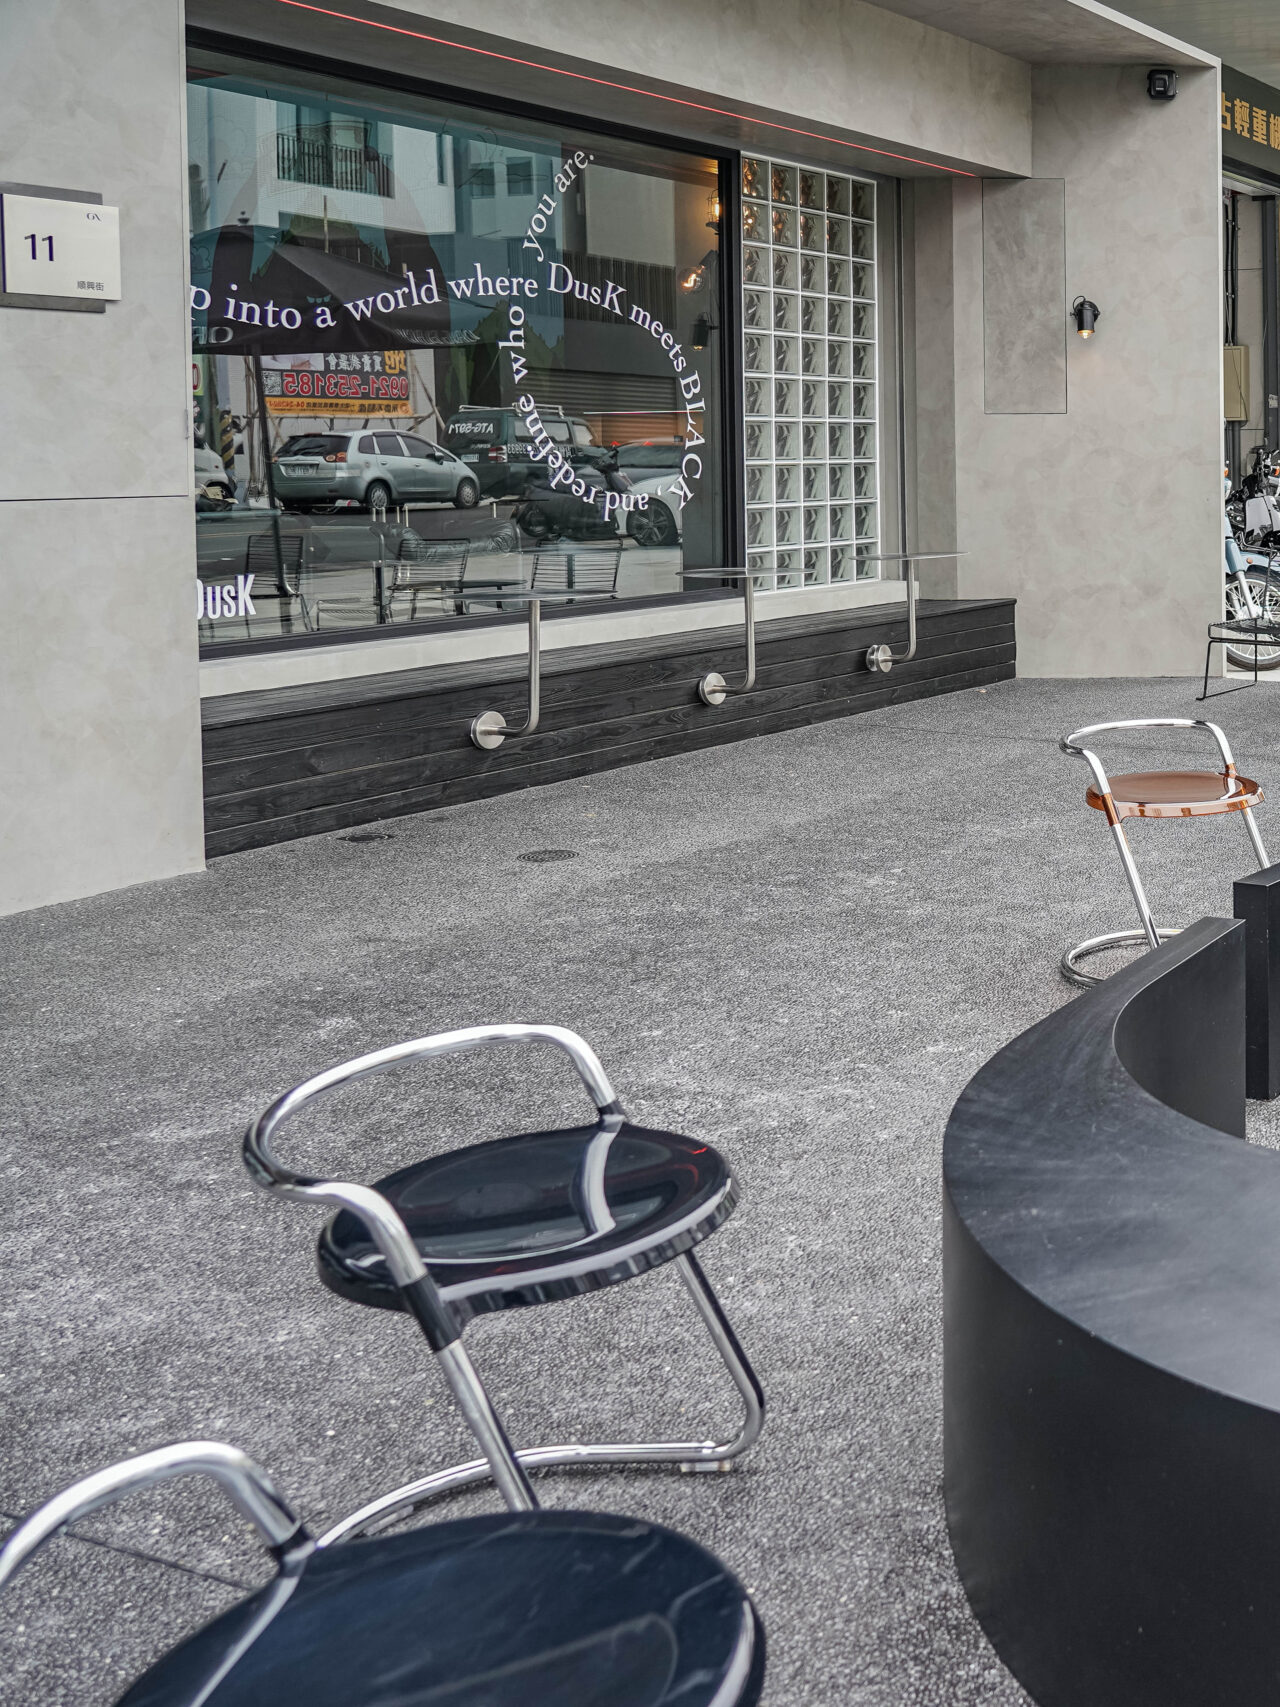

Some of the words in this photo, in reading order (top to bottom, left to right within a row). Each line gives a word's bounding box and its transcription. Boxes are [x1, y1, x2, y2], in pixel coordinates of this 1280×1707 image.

[554, 151, 594, 193] are.
[24, 233, 54, 261] 11
[522, 194, 557, 262] you
[344, 268, 442, 321] world
[448, 262, 538, 299] where
[547, 261, 627, 316] DusK
[223, 283, 302, 330] into
[316, 306, 337, 328] a
[498, 305, 528, 384] who
[629, 304, 687, 373] meets
[518, 393, 596, 505] redefine
[603, 491, 649, 522] and
